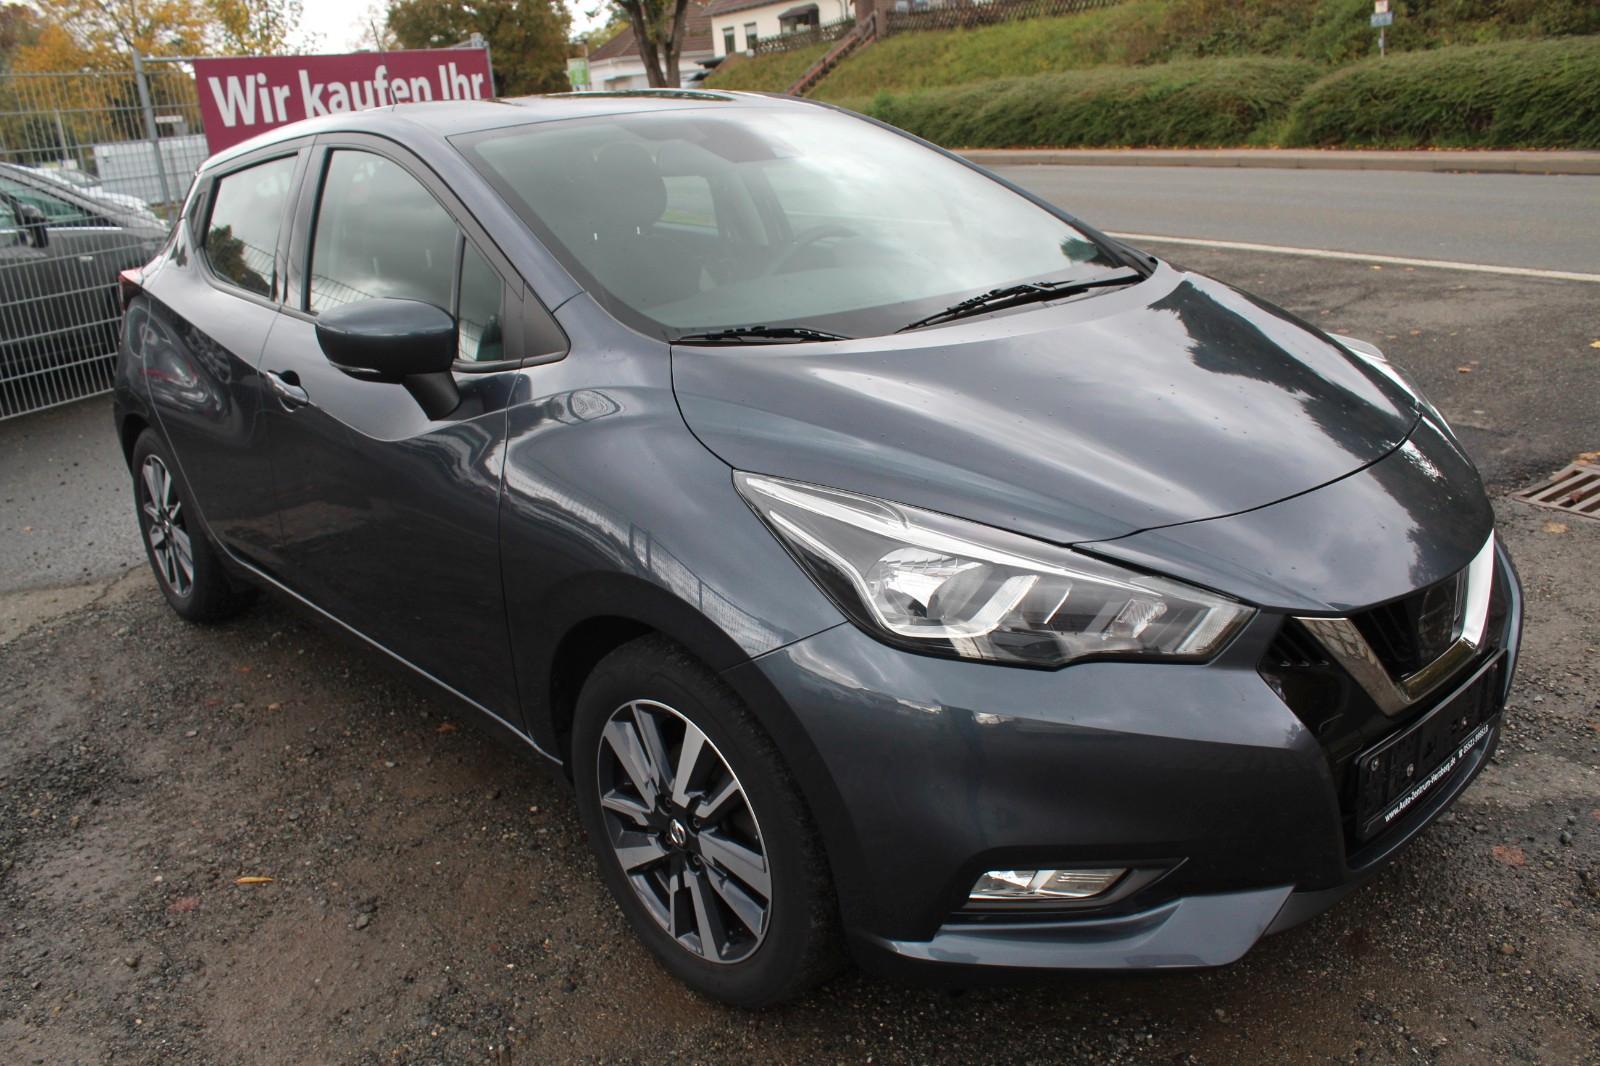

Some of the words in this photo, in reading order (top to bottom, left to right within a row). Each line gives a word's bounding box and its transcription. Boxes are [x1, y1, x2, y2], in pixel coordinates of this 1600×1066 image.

[207, 72, 290, 127] Wir
[298, 64, 432, 119] kaufen
[438, 62, 484, 100] Ihr
